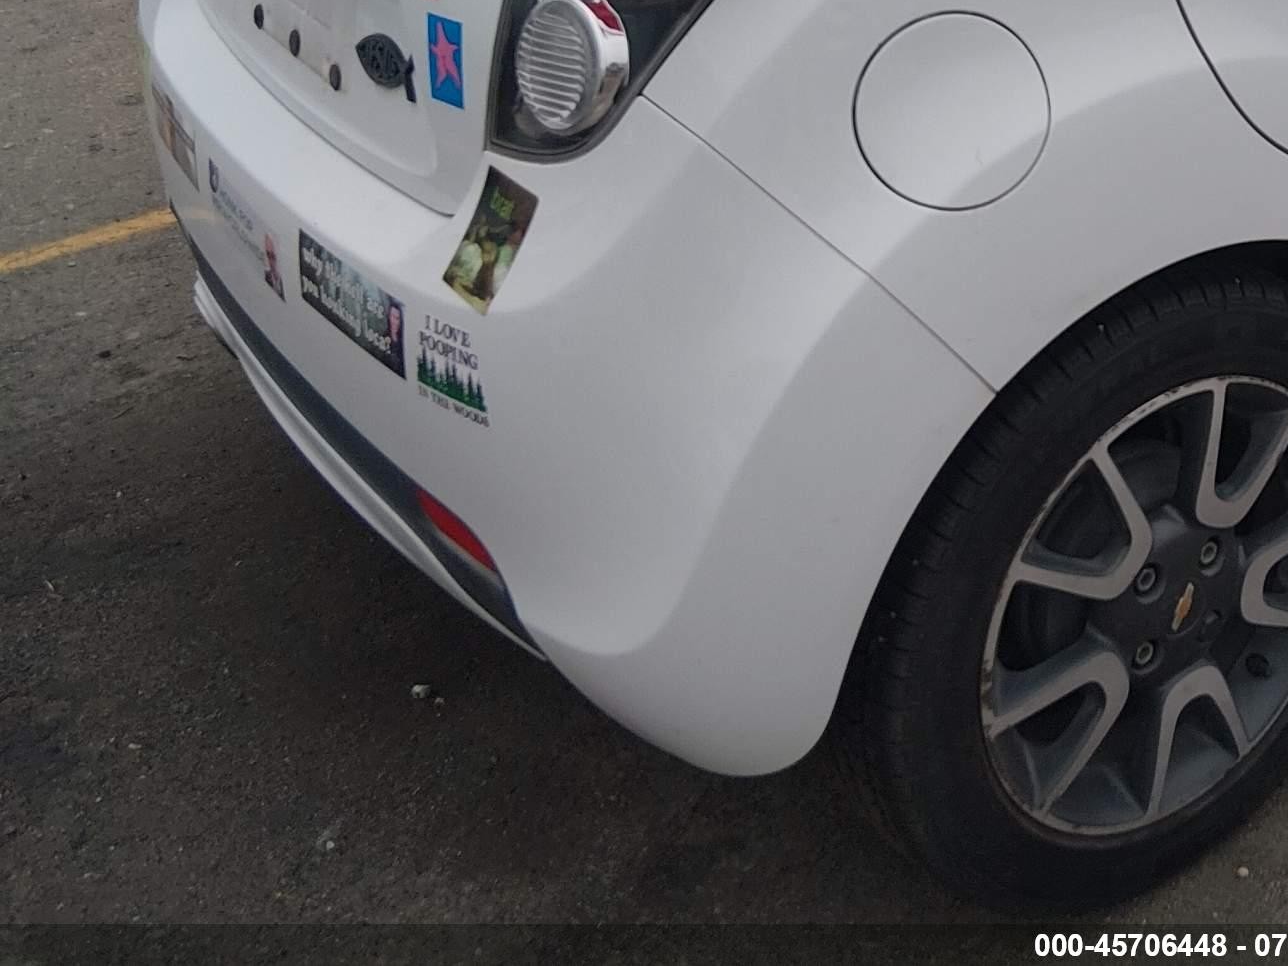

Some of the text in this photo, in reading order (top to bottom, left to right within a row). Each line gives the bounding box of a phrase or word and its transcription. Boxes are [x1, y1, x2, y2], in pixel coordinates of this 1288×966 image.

[424, 314, 472, 347] I LOVE
[418, 330, 479, 370] POOPING
